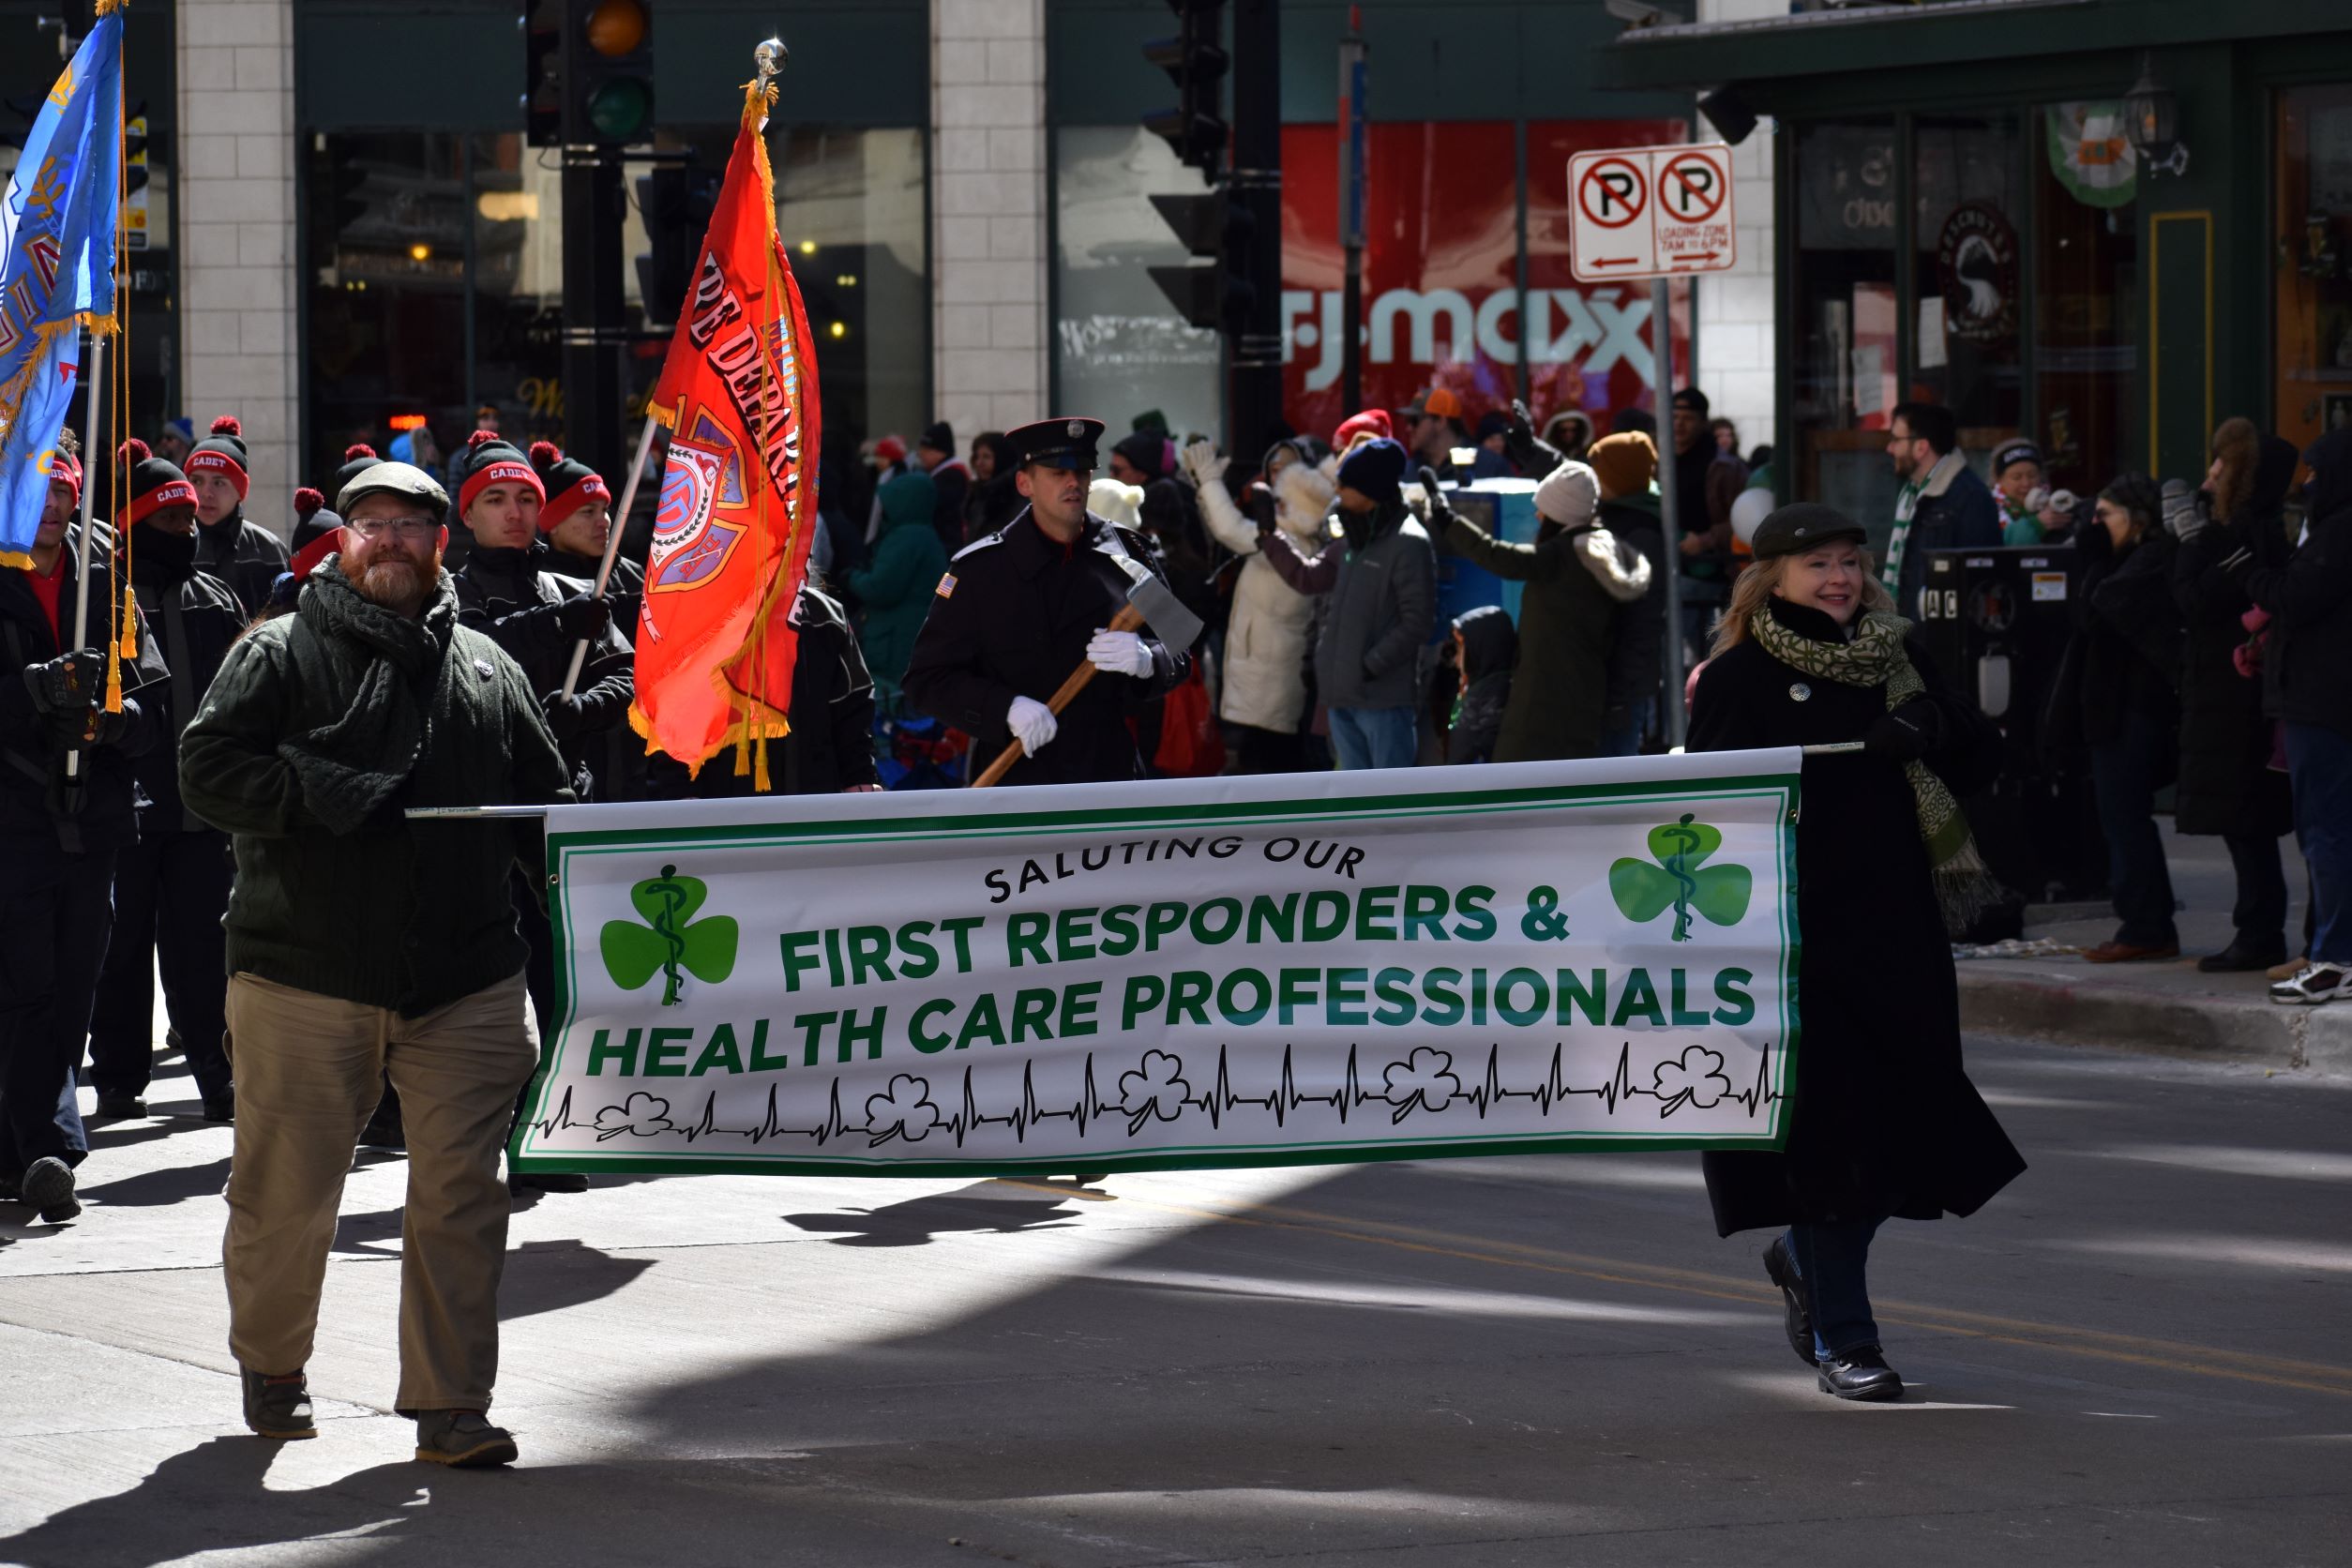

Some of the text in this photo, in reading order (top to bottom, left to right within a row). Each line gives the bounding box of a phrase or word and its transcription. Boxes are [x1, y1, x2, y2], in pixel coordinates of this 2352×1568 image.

[1658, 223, 1727, 240] LOADING ZONE
[1663, 240, 1684, 252] 7AM
[1701, 237, 1727, 249] 6PM
[192, 456, 226, 468] CADET
[490, 468, 531, 480] CADET
[158, 487, 191, 503] CADET
[984, 835, 1364, 903] SALUTING OUR
[780, 884, 1570, 992] FIRST RESPONDERS &
[585, 967, 1755, 1077] HEALTH CARE PROFESSIONALS
